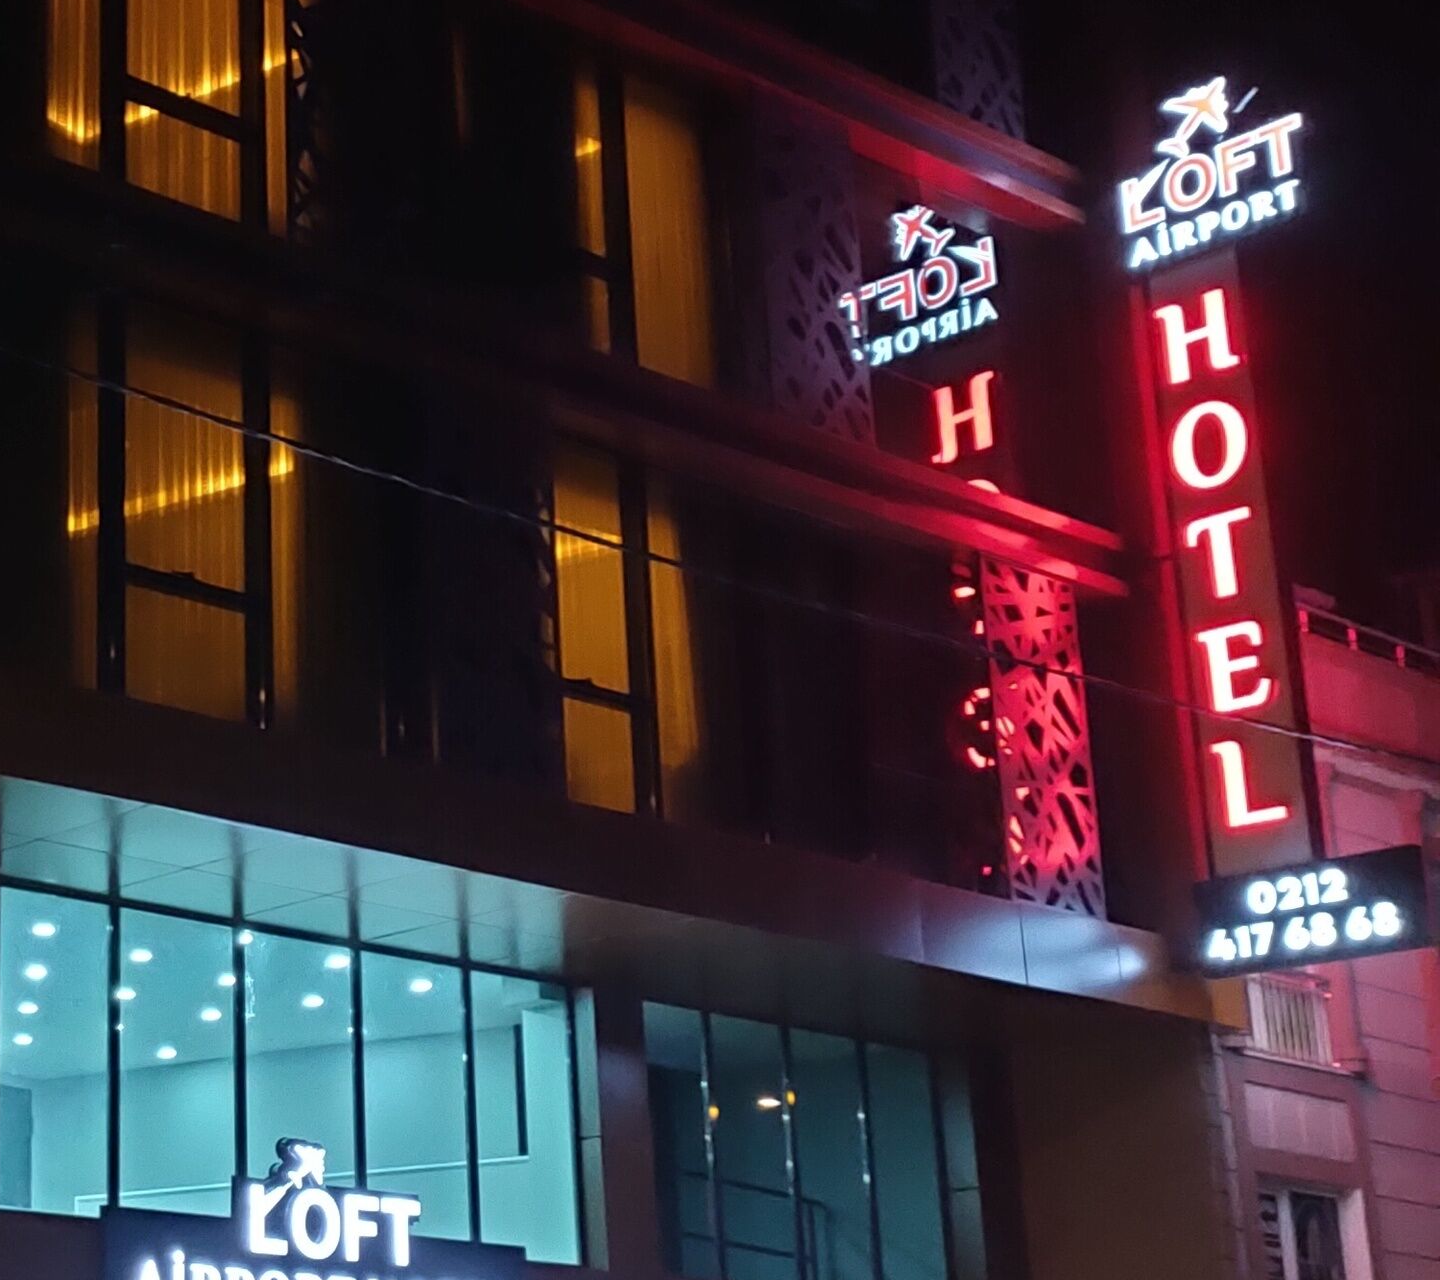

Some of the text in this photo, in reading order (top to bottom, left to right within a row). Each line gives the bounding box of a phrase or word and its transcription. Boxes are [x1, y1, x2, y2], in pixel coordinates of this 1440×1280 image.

[1121, 113, 1302, 233] LOFT
[1153, 288, 1289, 830] HOTEL
[1208, 901, 1400, 960] 417 68 68
[1247, 868, 1349, 914] 0212
[248, 1183, 421, 1267] LOFT
